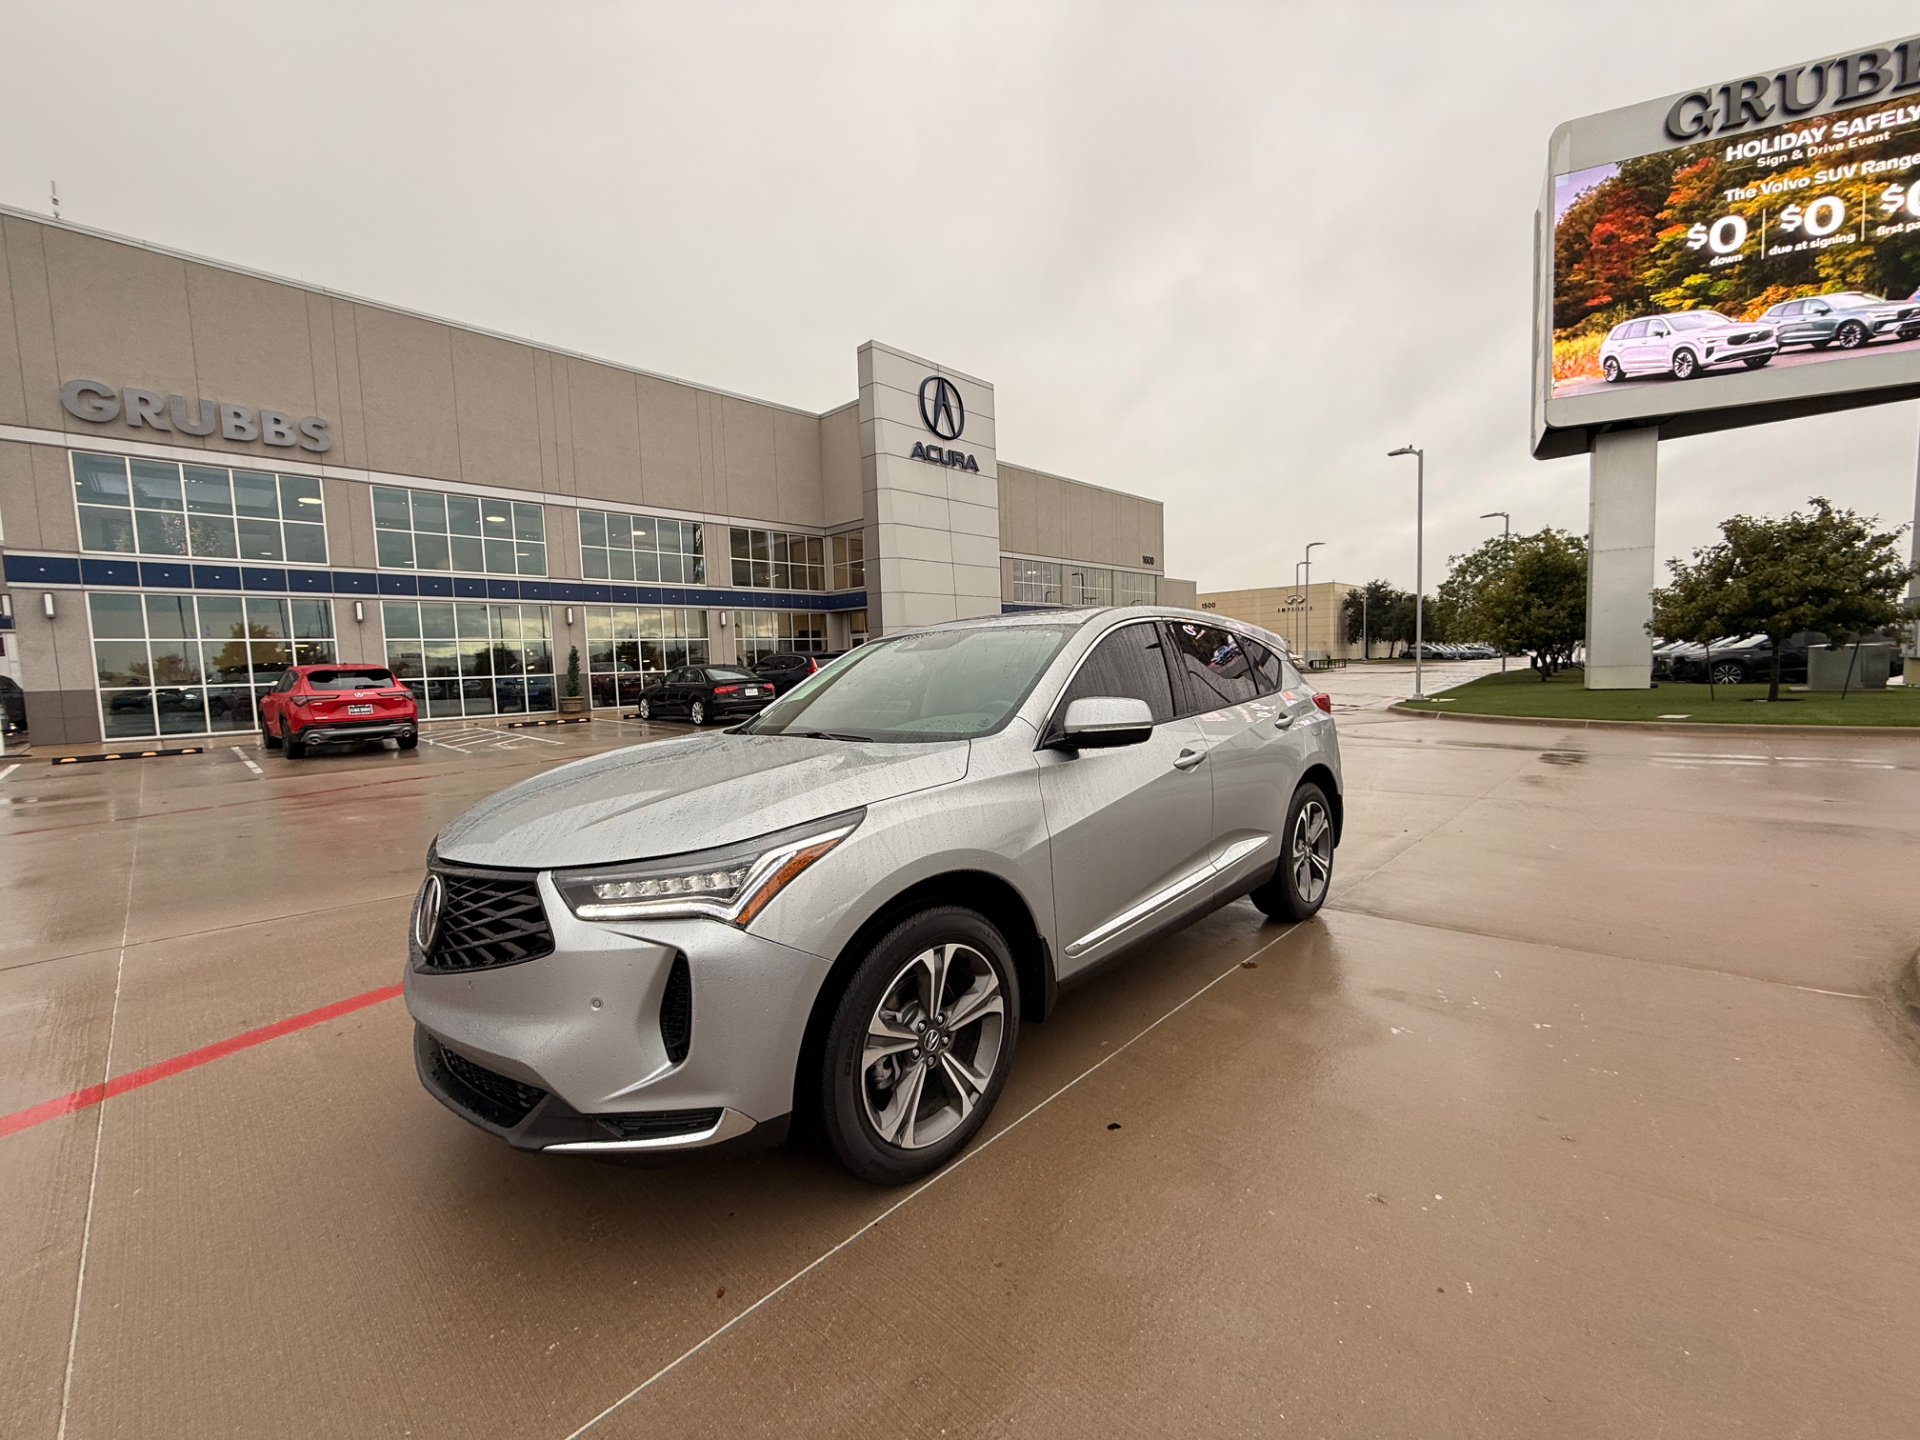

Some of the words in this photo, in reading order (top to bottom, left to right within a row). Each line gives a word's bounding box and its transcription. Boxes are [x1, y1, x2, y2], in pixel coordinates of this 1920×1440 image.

[1726, 125, 1828, 162] HOLIDAY
[1831, 104, 1920, 139] SAFELY
[1757, 153, 1788, 169] Sign
[1791, 149, 1804, 161] &
[1807, 141, 1845, 158] Drive
[1848, 130, 1891, 149] Event
[1724, 186, 1757, 203] The
[1761, 176, 1811, 195] Volvo
[1814, 163, 1858, 185] SUV
[1861, 153, 1920, 175] Range
[1686, 214, 1748, 254] $0
[1779, 195, 1846, 236] $0
[1876, 222, 1904, 237] first
[1709, 253, 1743, 267] down
[1768, 244, 1793, 256] due
[1795, 241, 1808, 252] at
[1809, 232, 1856, 249] signing
[60, 379, 332, 453] GRUBBS
[911, 441, 980, 472] ACURA
[1142, 554, 1154, 566] 1600
